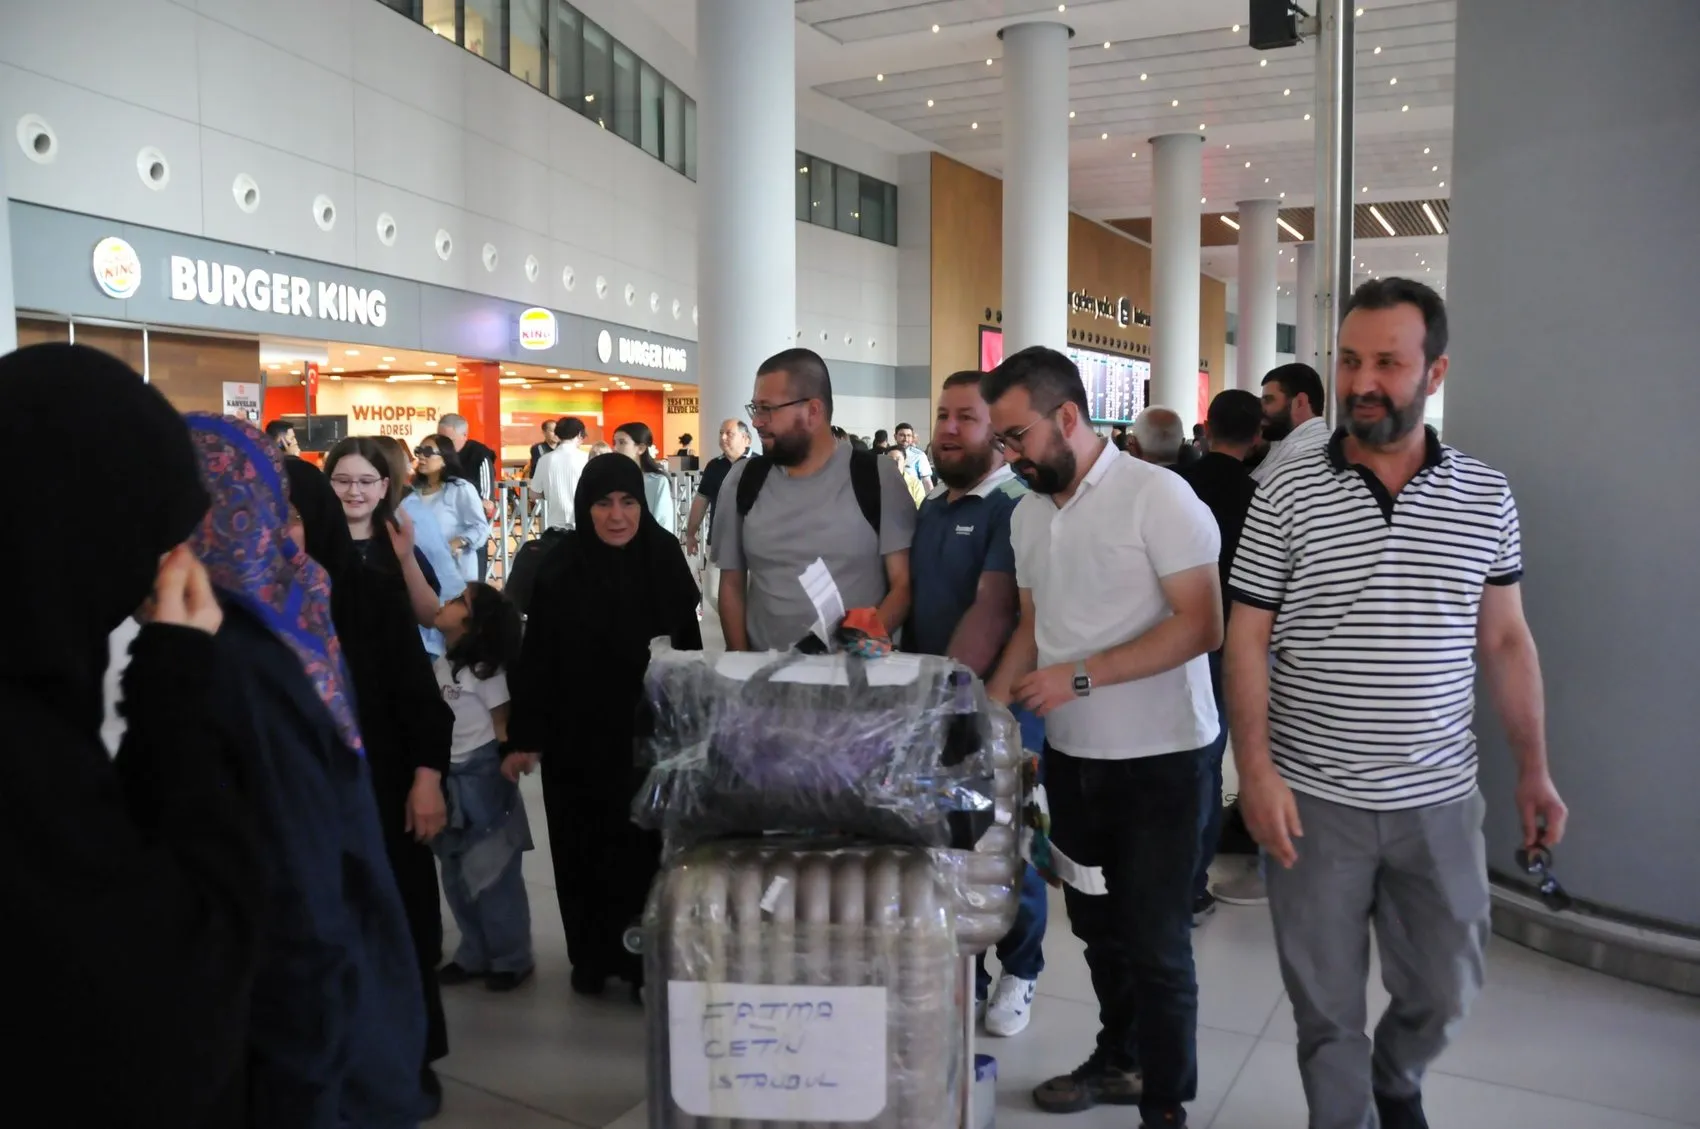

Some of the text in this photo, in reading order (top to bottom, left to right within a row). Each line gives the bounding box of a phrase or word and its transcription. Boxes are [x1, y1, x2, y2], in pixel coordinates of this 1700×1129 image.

[171, 255, 387, 327] BURGER KING
[619, 337, 687, 372] BURGER KING
[703, 1001, 833, 1030] FATMA
